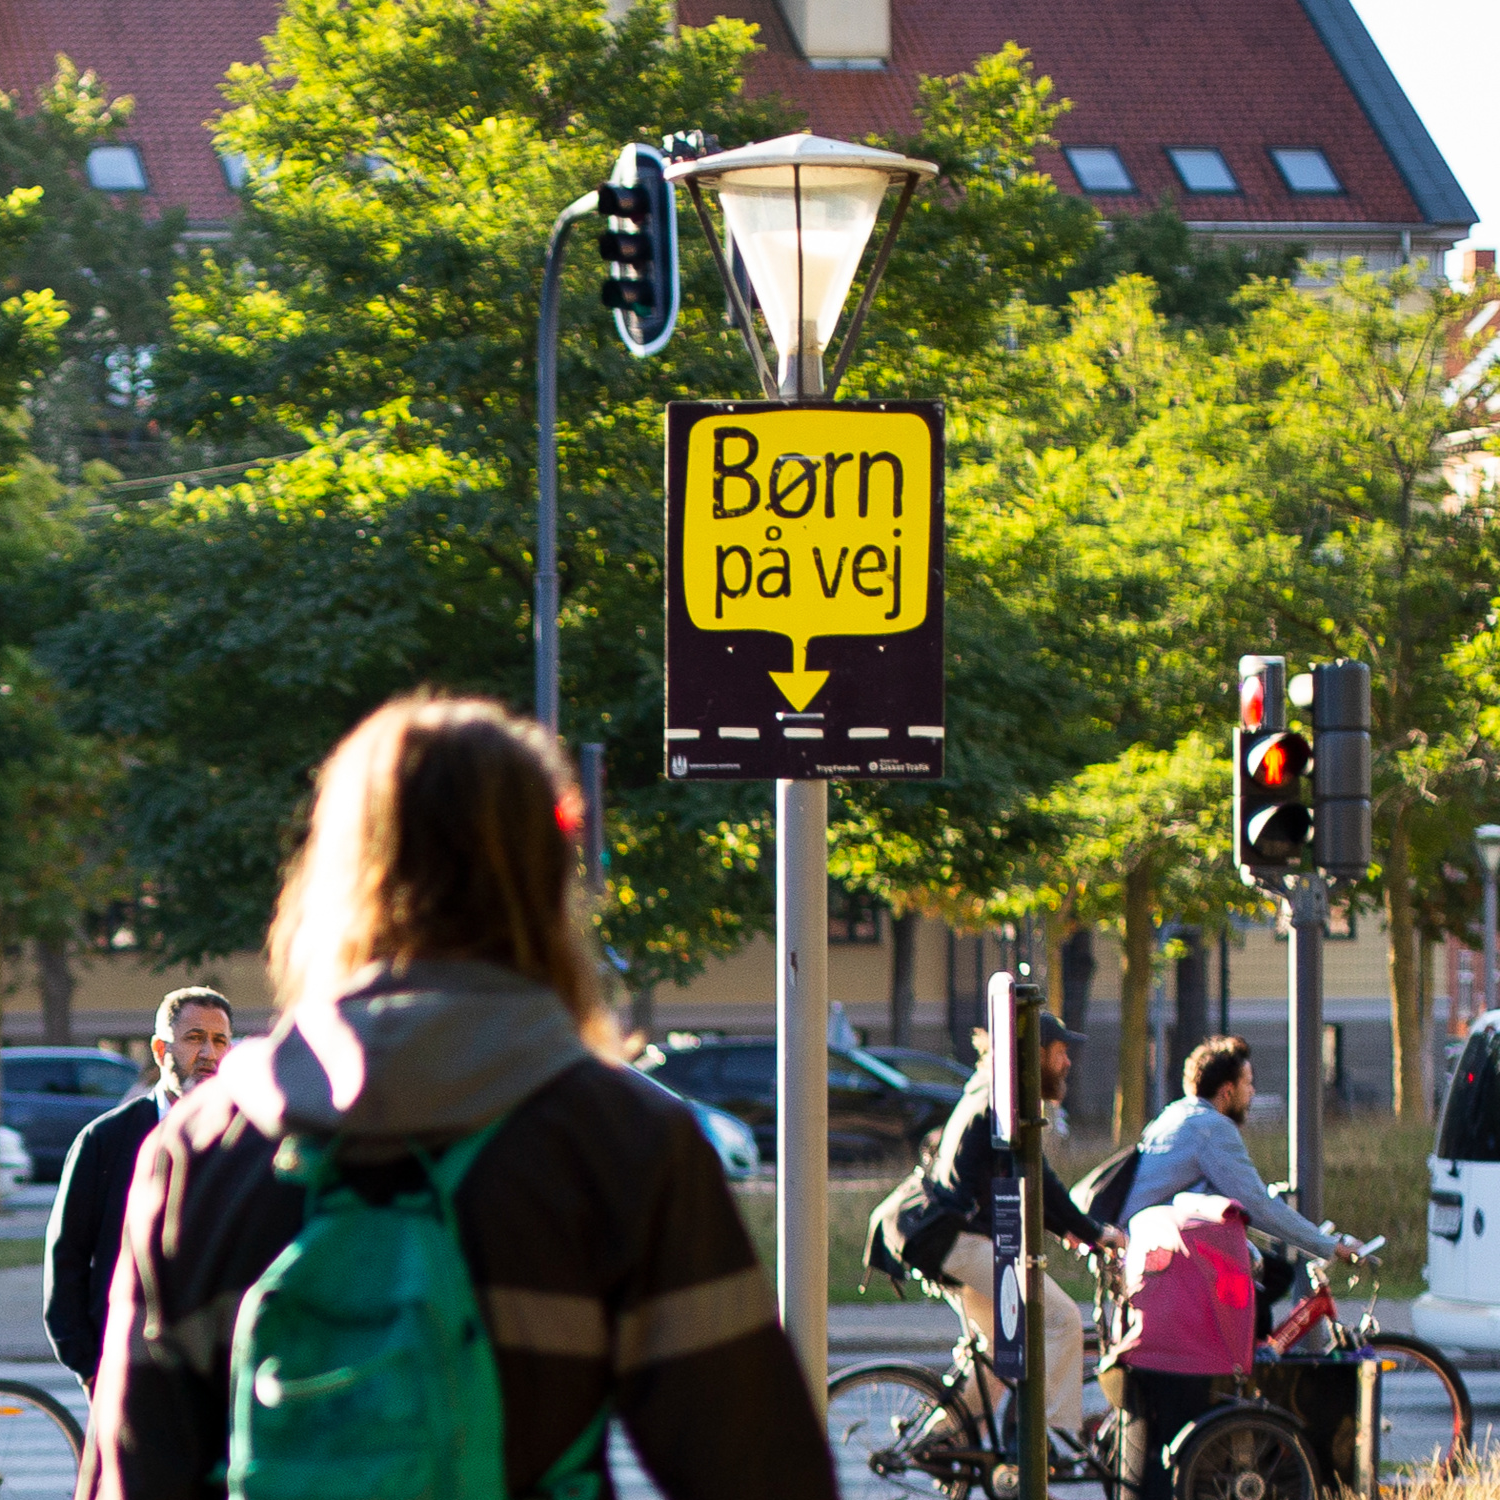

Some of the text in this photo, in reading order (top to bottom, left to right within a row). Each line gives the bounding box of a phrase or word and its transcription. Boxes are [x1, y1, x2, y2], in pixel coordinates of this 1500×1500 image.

[713, 427, 904, 519] Børn
[715, 526, 902, 620] på vej
